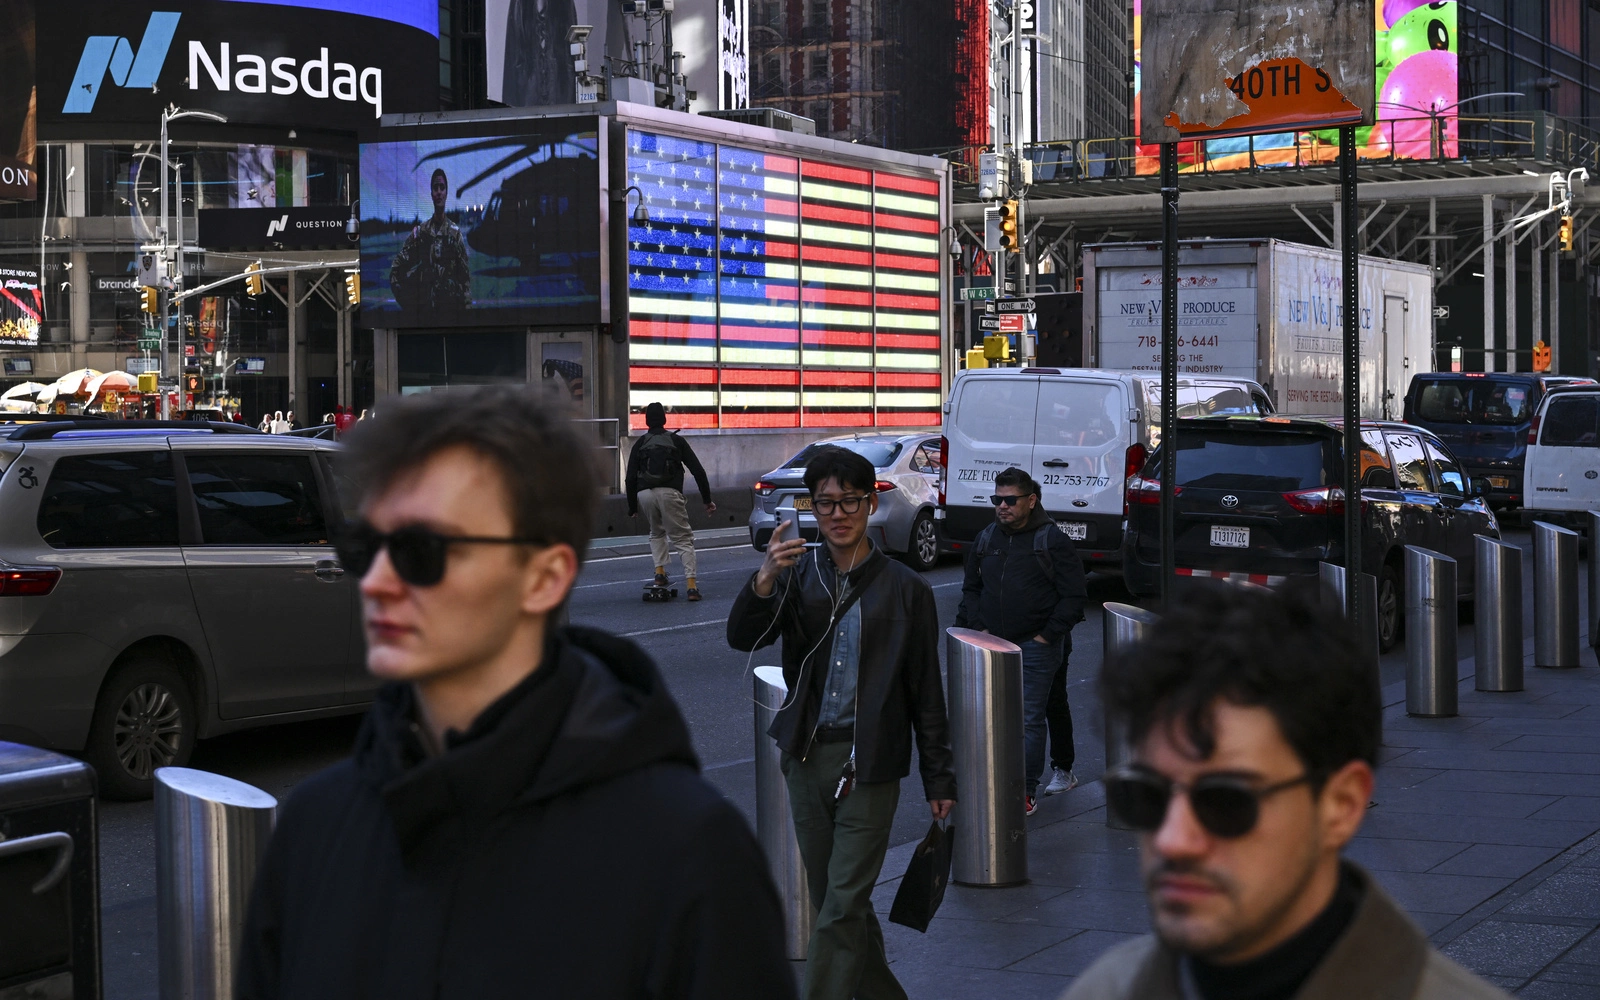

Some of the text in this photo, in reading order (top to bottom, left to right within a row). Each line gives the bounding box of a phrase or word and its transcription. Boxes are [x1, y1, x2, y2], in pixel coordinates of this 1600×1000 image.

[188, 40, 382, 119] Nasdaq
[1230, 64, 1300, 100] 40TH
[2, 166, 29, 186] ON
[295, 220, 343, 229] QUESTION
[969, 290, 976, 298] W
[978, 289, 987, 298] 43
[1120, 303, 1145, 314] NEW
[1183, 301, 1236, 314] PRODUCE
[1289, 300, 1309, 322] NEW
[1177, 317, 1225, 325] EGETABLES
[1138, 335, 1219, 348] 718-6-6441
[1296, 338, 1319, 350] FRUITS
[1189, 354, 1203, 362] THE
[1185, 365, 1224, 373] INDUSTRY
[1288, 389, 1309, 402] SERVING
[1310, 390, 1319, 402] THE
[1043, 474, 1110, 487] 212-753-7767
[1214, 530, 1247, 543] T131712C
